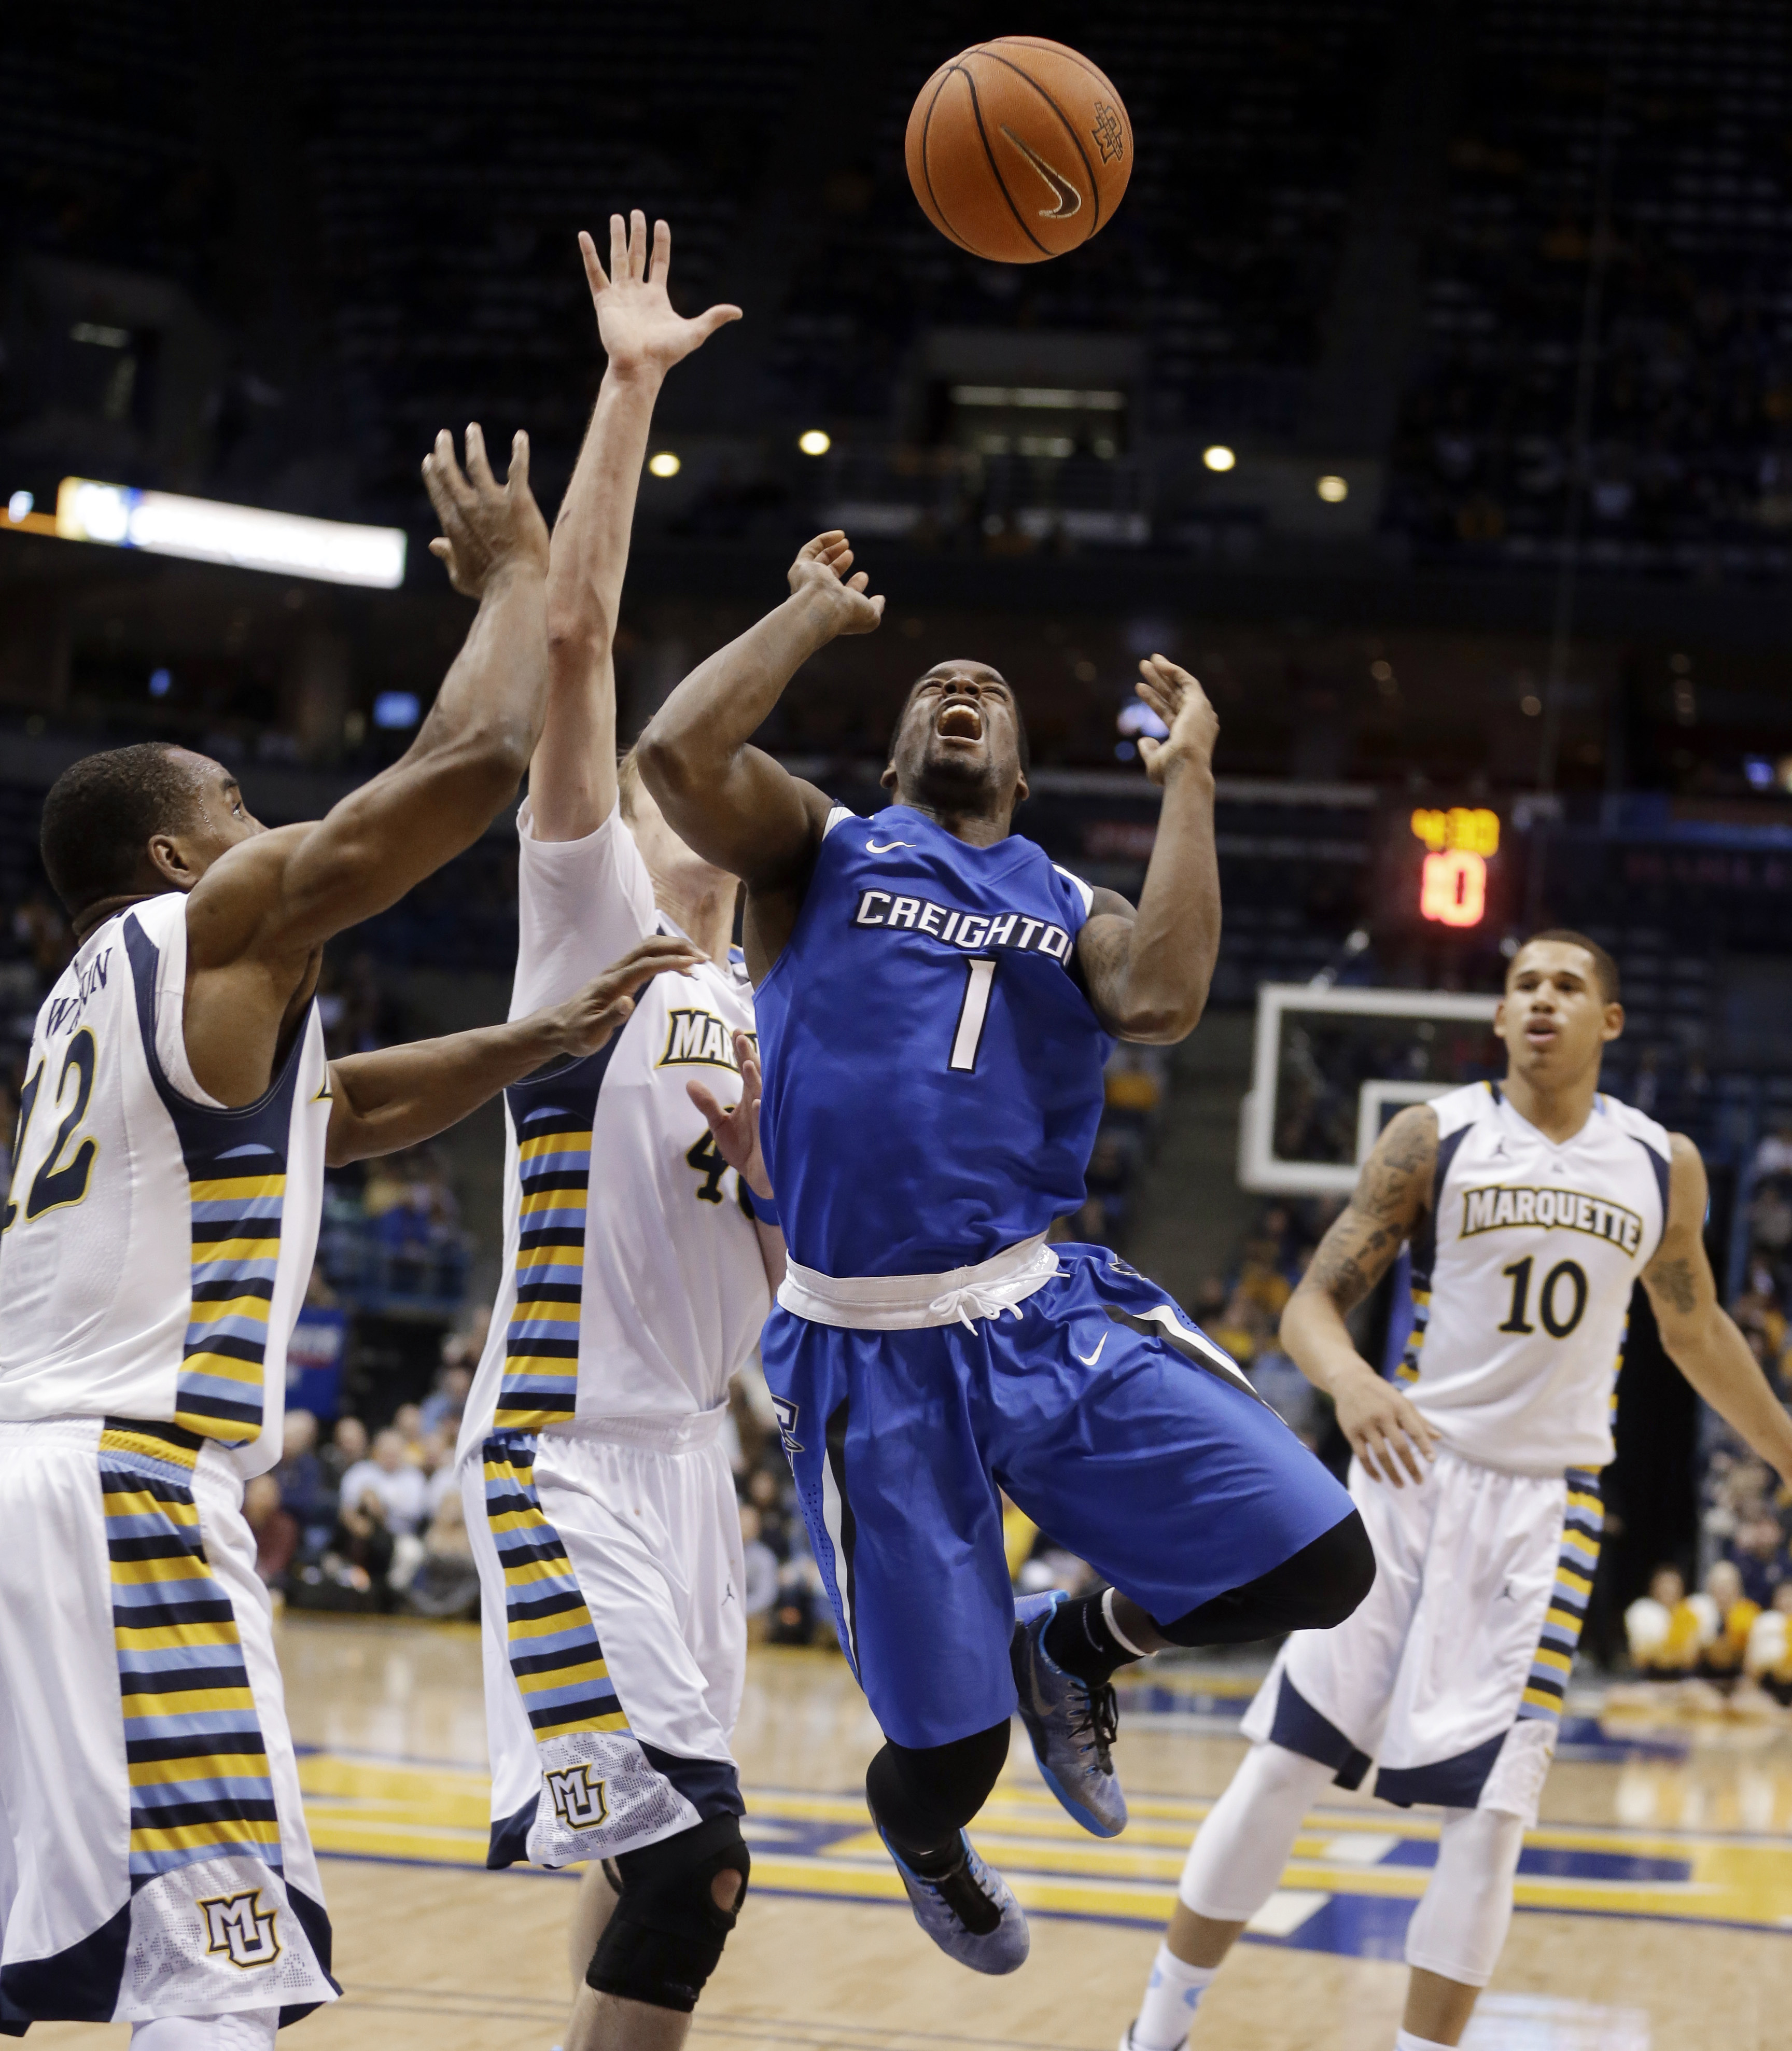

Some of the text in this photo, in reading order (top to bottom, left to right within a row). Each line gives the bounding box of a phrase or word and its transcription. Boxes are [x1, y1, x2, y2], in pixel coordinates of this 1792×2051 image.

[947, 957, 998, 1073] 1
[686, 1103, 755, 1220] 4
[1458, 1183, 1643, 1259] MARQUETTE
[1497, 1255, 1589, 1340] 10
[544, 1762, 609, 1832] MU
[196, 1888, 283, 1971] MU
